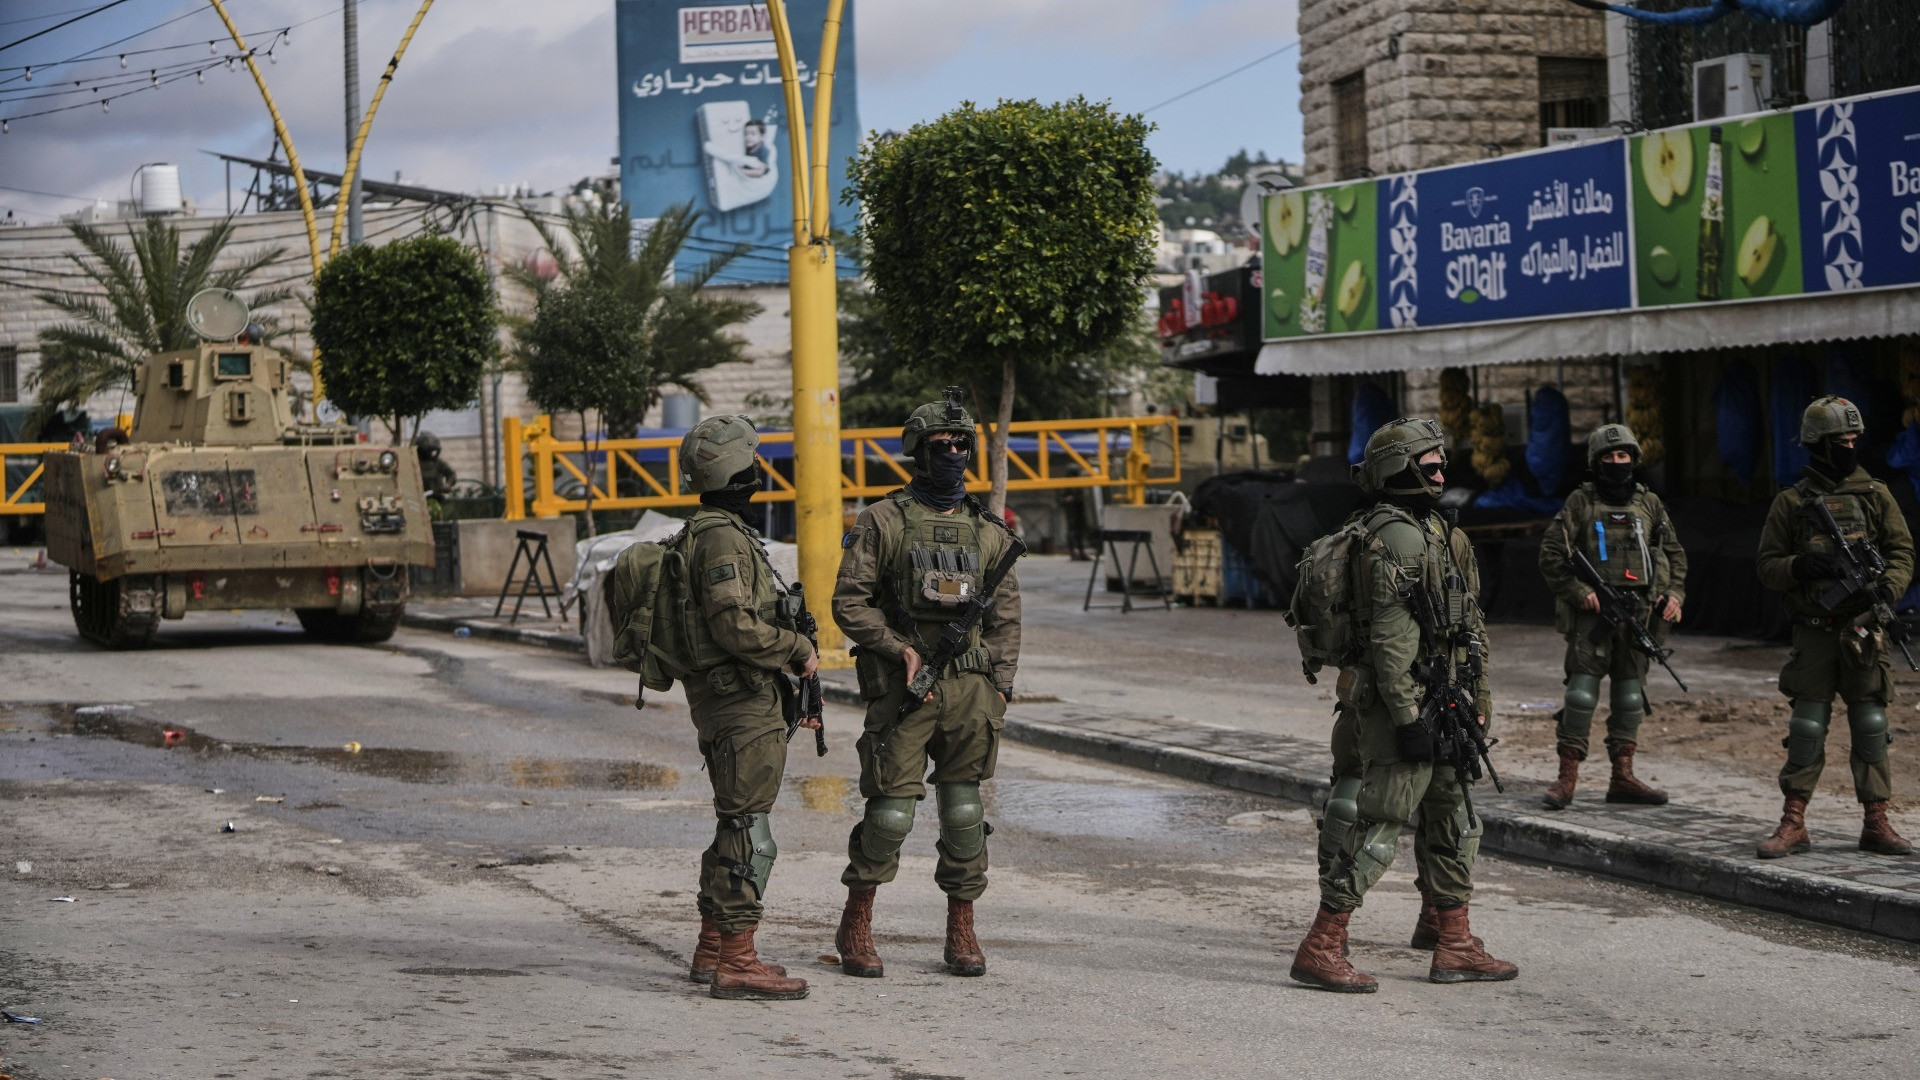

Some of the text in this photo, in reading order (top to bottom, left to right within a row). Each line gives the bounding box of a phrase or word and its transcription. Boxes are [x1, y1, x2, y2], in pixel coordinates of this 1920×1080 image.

[684, 8, 774, 34] HERBAW
[1572, 178, 1613, 214] محلات
[1441, 214, 1511, 251] Bavaria
[1579, 231, 1624, 279] للخضار
